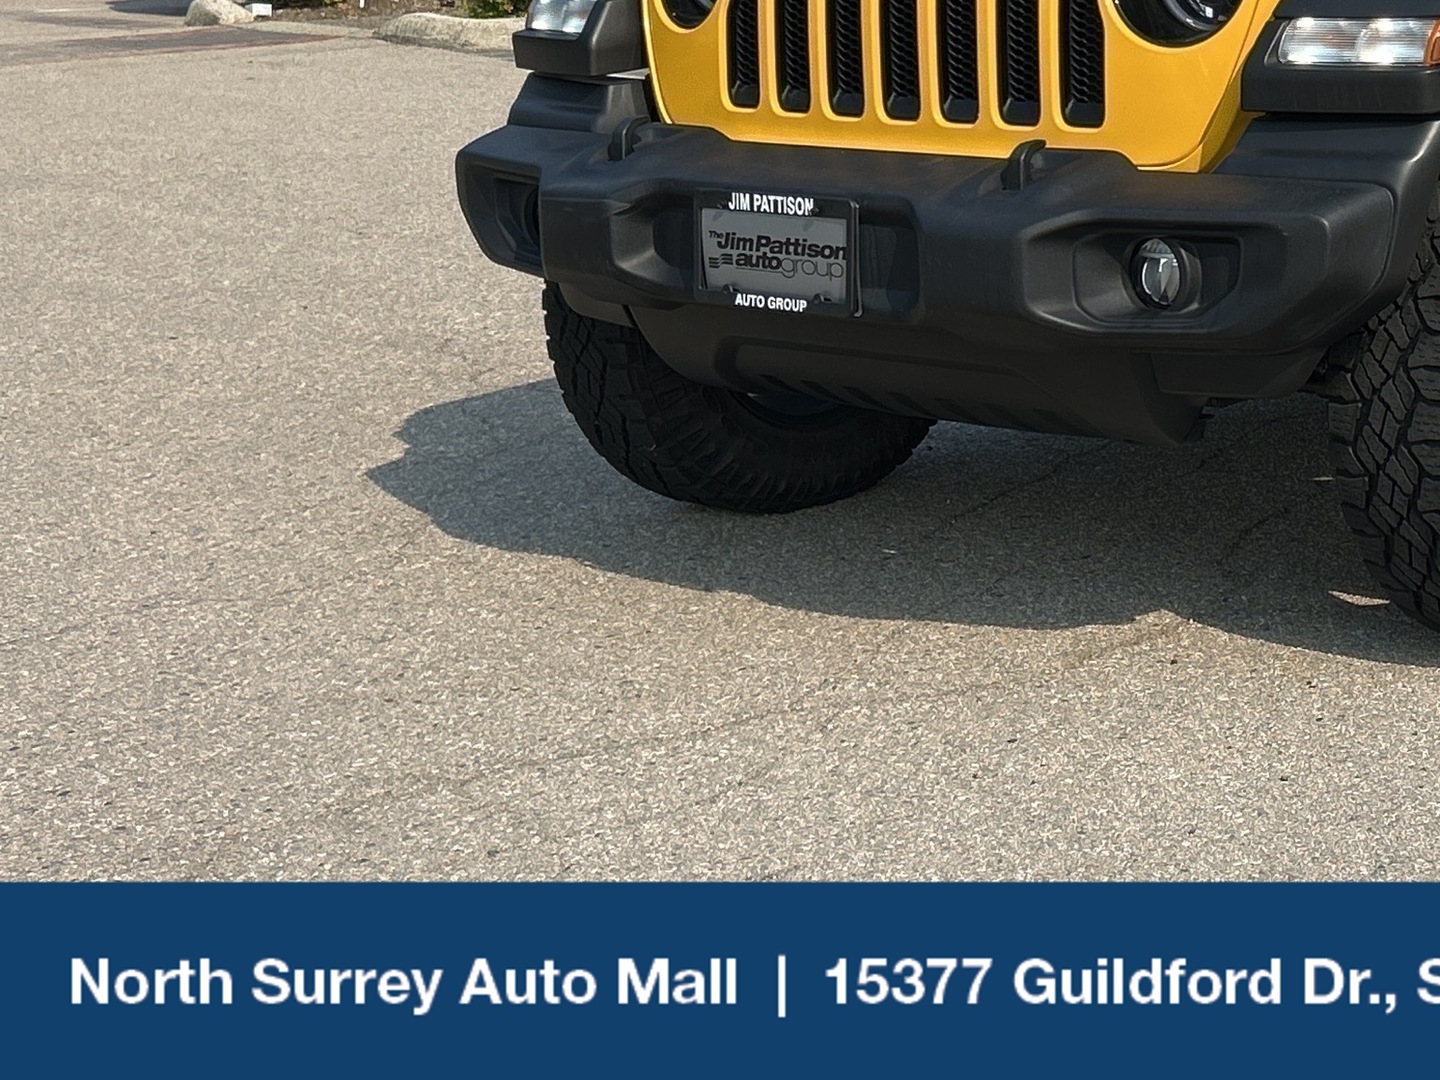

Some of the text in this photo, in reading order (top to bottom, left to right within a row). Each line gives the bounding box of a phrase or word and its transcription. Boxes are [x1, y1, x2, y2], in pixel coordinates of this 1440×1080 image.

[728, 192, 814, 216] JIM PATTISON
[717, 232, 754, 252] Jim
[755, 235, 847, 261] Pattison
[735, 293, 807, 312] AUTO GROUP
